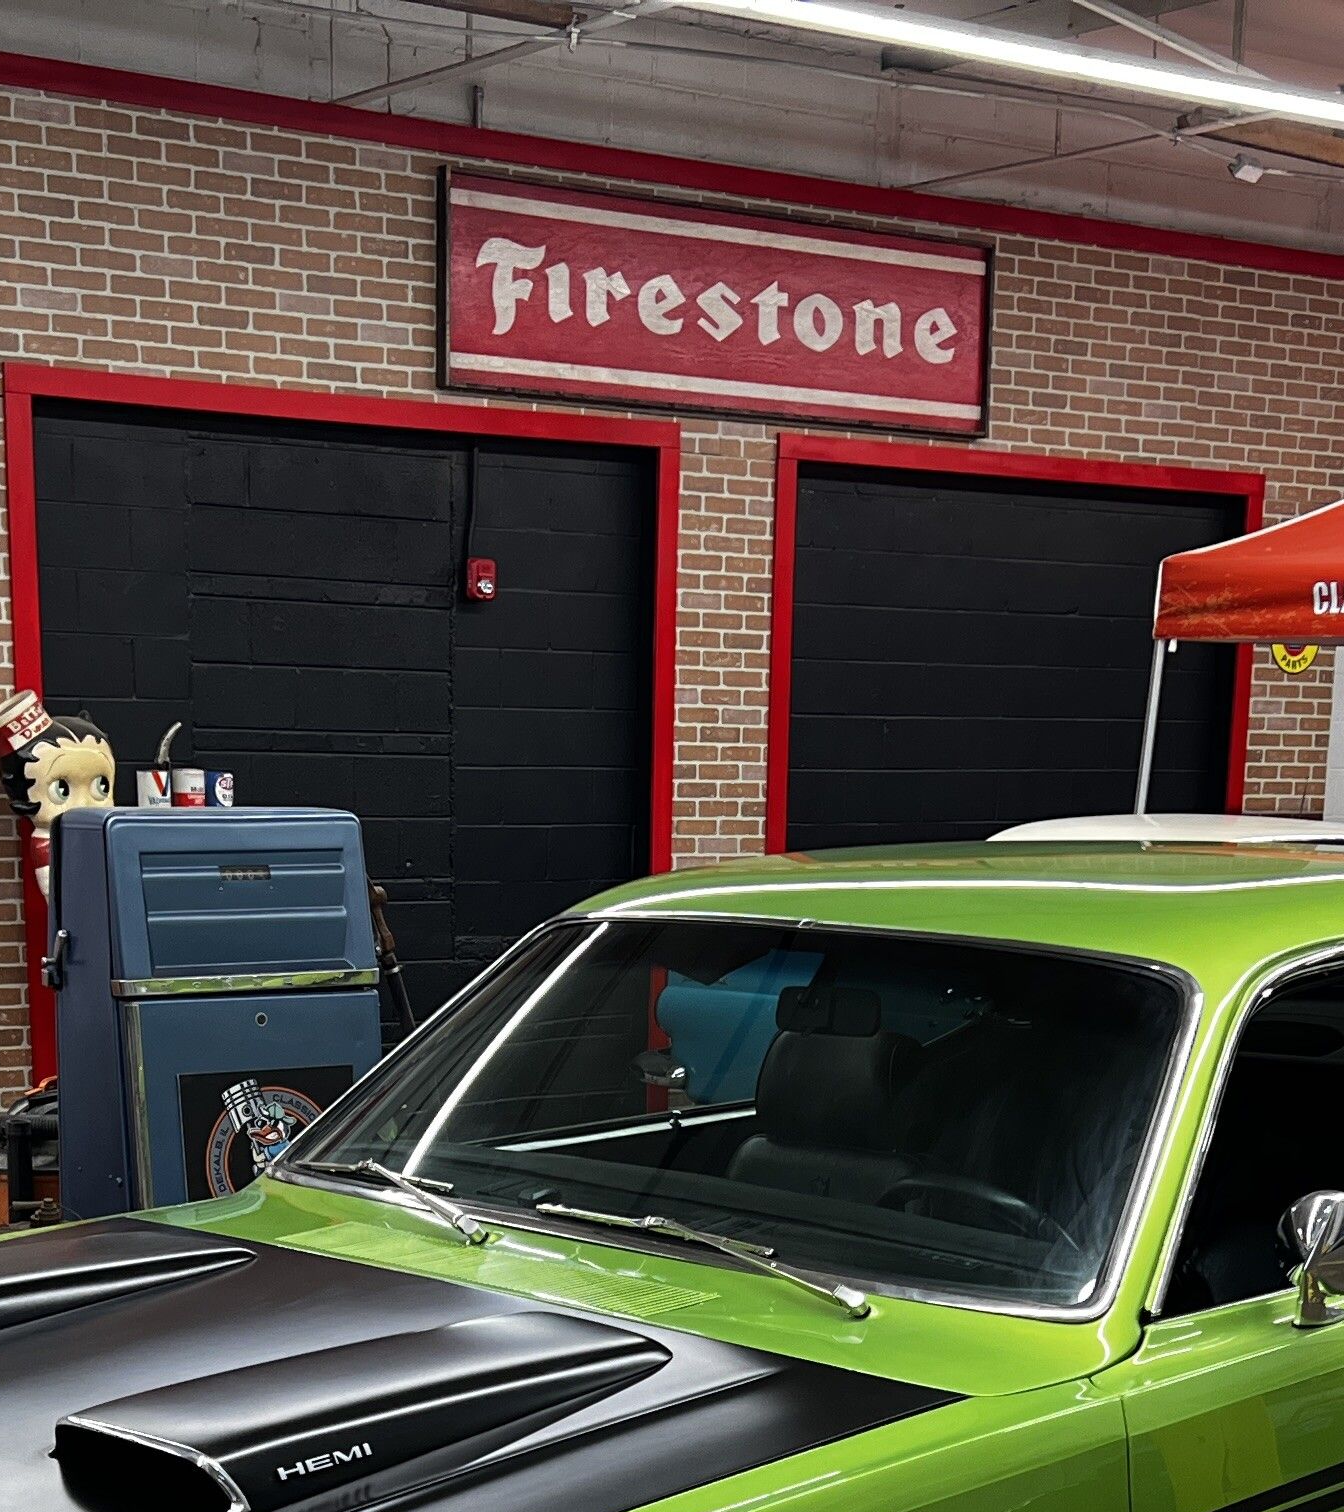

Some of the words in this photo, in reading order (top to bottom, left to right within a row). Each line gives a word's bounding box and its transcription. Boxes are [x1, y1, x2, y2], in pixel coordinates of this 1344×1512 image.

[475, 237, 958, 364] Firestone
[1281, 653, 1309, 671] PARTS
[276, 1442, 373, 1481] HEMI
